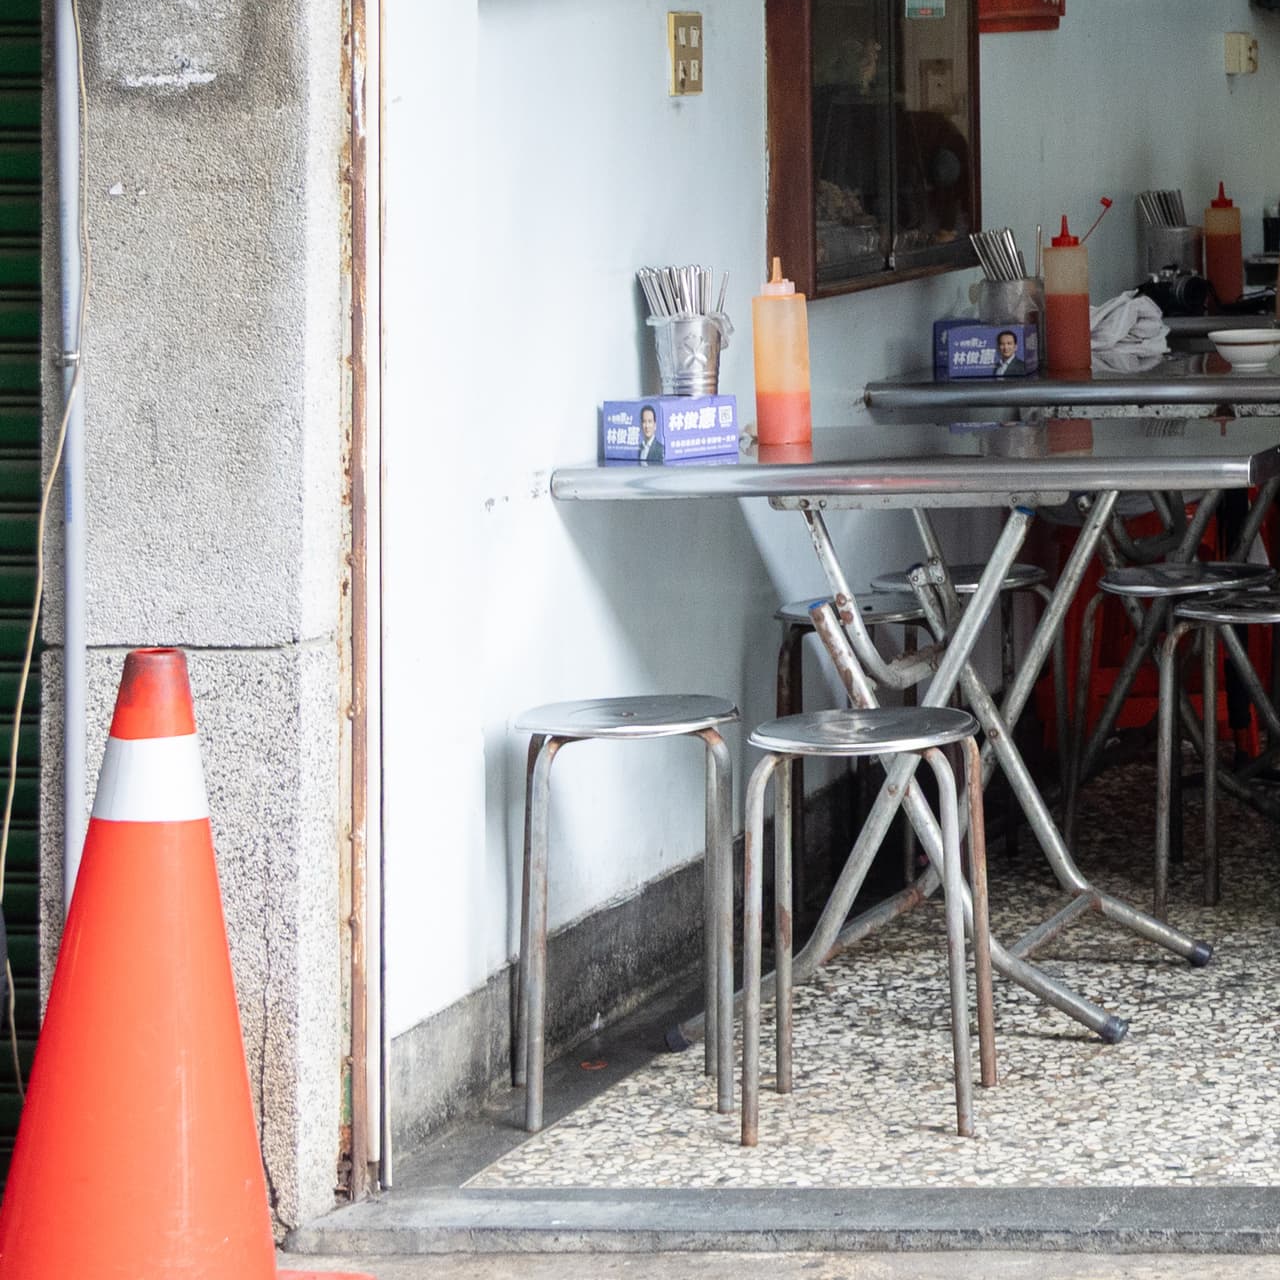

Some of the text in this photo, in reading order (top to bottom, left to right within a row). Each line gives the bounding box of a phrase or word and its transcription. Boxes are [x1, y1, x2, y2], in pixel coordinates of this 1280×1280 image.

[953, 348, 996, 365] 林俊憲
[669, 406, 717, 431] 林俊憲
